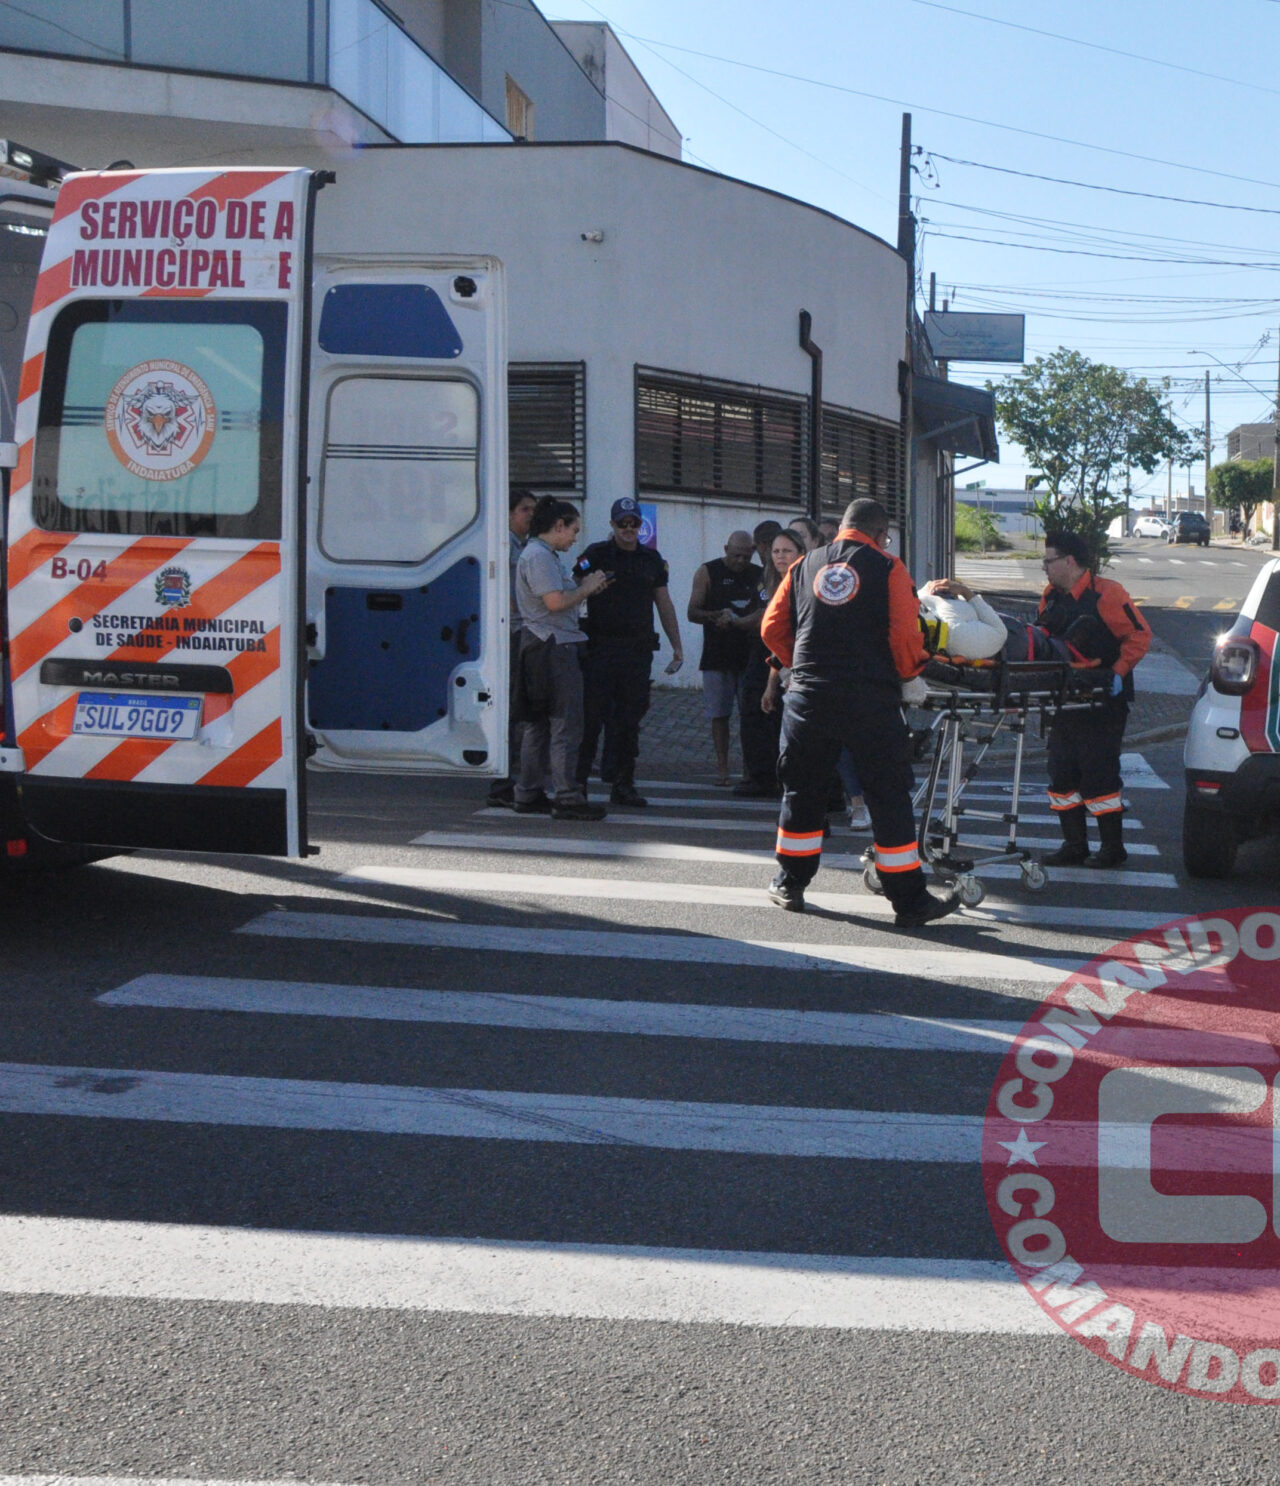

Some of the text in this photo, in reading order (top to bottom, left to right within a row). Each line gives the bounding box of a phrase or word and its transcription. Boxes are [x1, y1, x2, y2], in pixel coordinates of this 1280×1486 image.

[80, 199, 295, 247] SERVIÇO DE A
[71, 249, 293, 290] MUNICIPAL E
[126, 460, 196, 480] INDAIATUBA
[51, 556, 108, 582] B-04
[92, 614, 267, 635] SECRETARIA MUNICIPAL
[95, 632, 114, 647] DE
[116, 631, 164, 649] SAÚDE
[175, 636, 267, 653] INDAIATUBA
[82, 670, 181, 687] MASTER
[83, 706, 185, 734] SUL9G09
